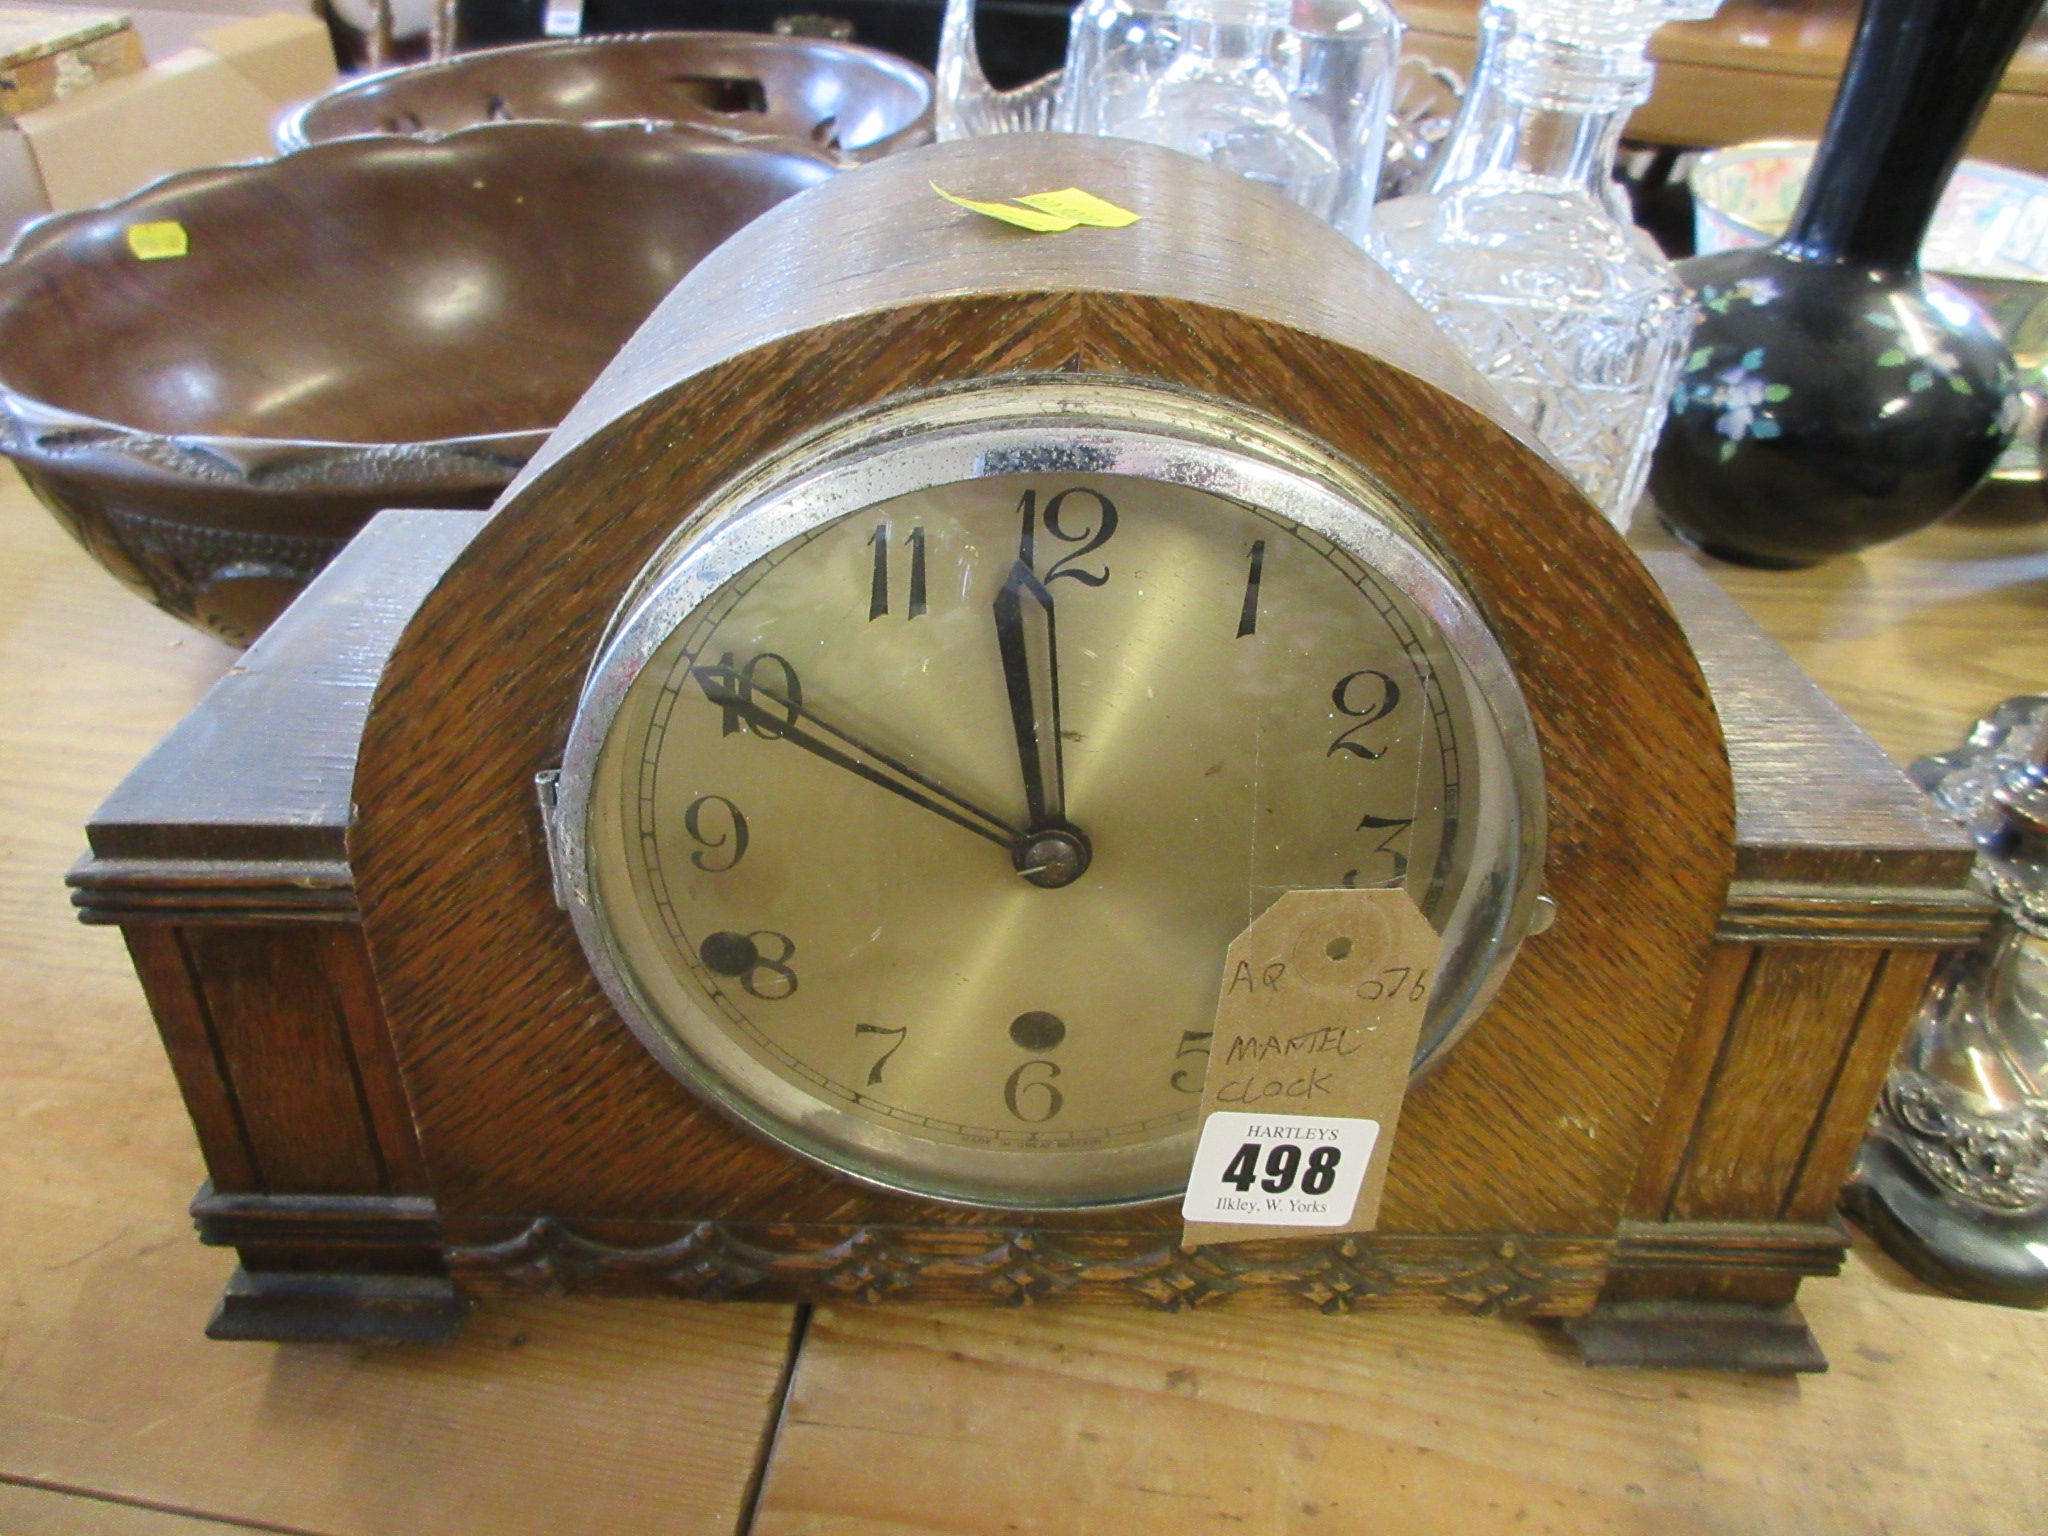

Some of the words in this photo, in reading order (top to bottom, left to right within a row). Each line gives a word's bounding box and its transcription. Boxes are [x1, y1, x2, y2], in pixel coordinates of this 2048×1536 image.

[1015, 487, 1119, 587] 12
[867, 524, 928, 622] 11
[1236, 540, 1266, 639] 1
[715, 651, 803, 741] 10
[1326, 669, 1400, 760] 2
[684, 795, 750, 872] 9
[738, 930, 799, 1000] 8
[854, 1023, 908, 1087] 7
[1225, 1026, 1362, 1066] MANTEL
[1003, 1060, 1064, 1123] 6
[1216, 1067, 1333, 1104] CLOCK
[1247, 1125, 1339, 1141] HARTLEYS
[1221, 1143, 1342, 1196] 498
[1215, 1197, 1260, 1214] Ilkley,
[1265, 1199, 1283, 1212] W.
[1289, 1199, 1328, 1213] Yorks
